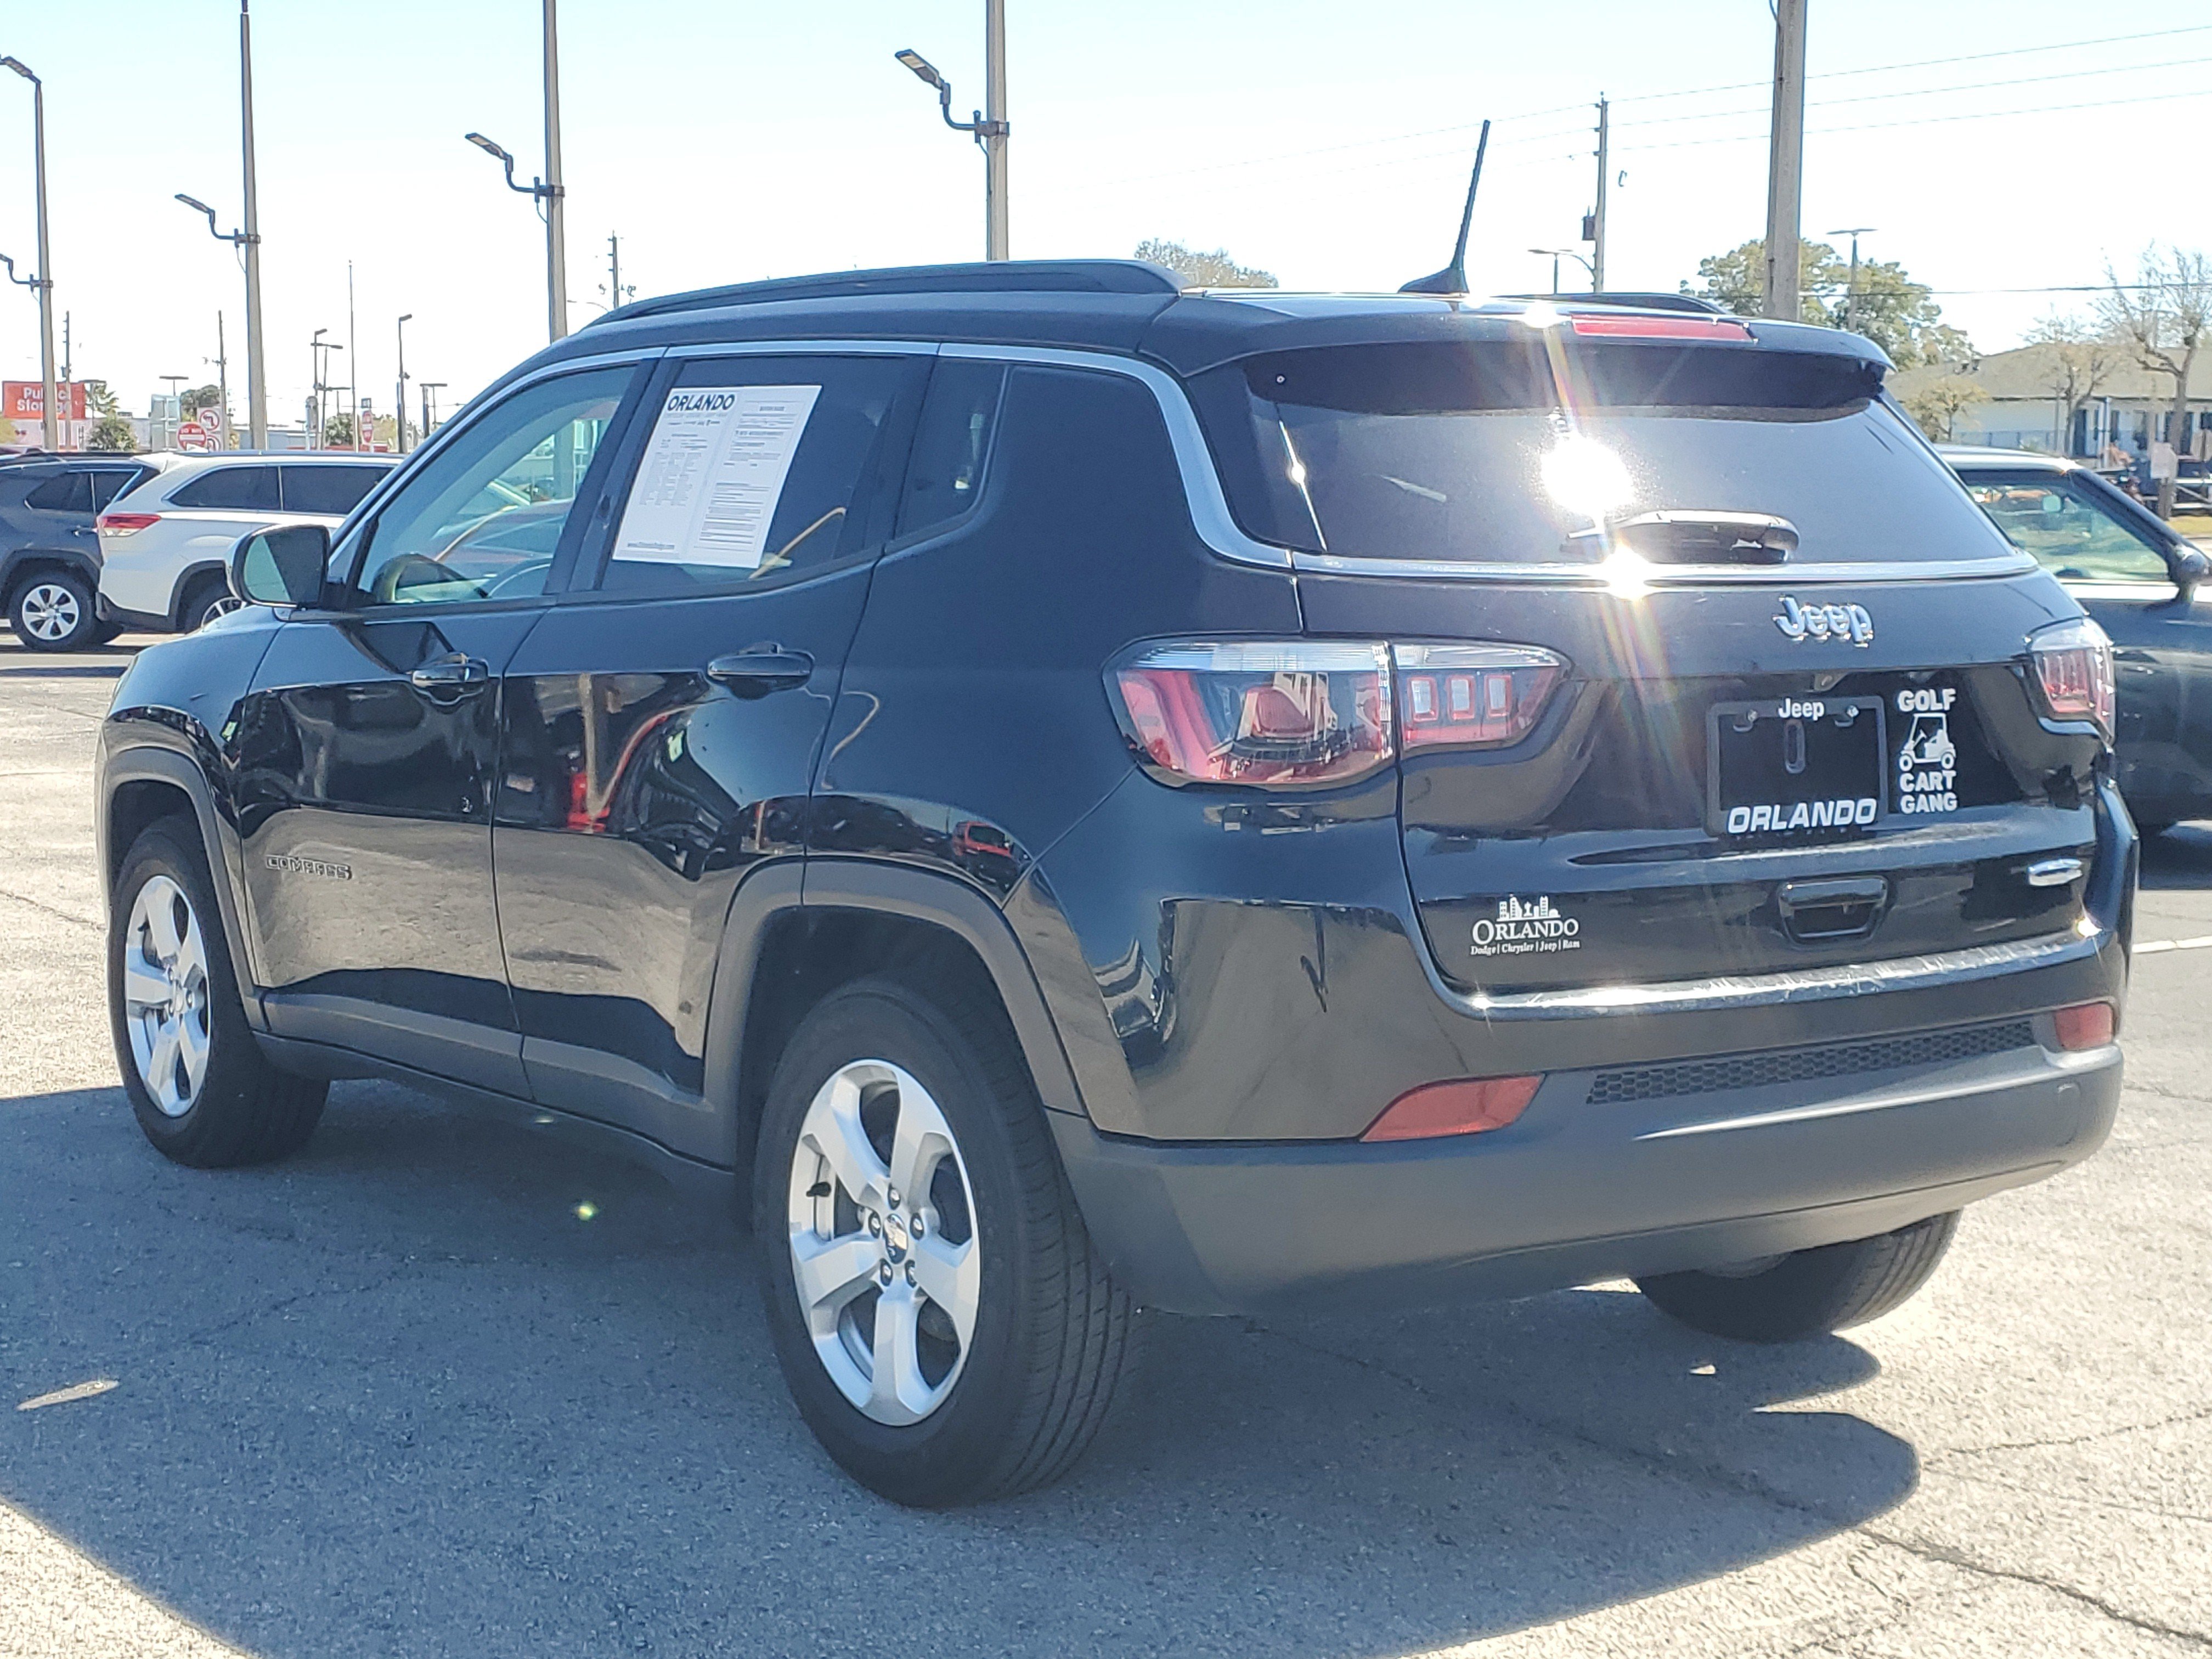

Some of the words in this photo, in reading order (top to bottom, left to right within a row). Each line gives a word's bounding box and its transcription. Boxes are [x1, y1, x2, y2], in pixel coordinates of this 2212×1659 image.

[667, 394, 735, 411] ORLANDO
[1773, 594, 1874, 648] Jeep
[1778, 698, 1825, 721] Jeep
[1898, 689, 1956, 712] GOLF
[1899, 770, 1957, 792] CART
[1900, 792, 1958, 813] GANG
[1728, 798, 1877, 834] ORLANDO
[1472, 918, 1579, 945] ORLANDO
[1471, 945, 1496, 956] Dodge
[1502, 942, 1534, 954] Chrysler
[1540, 940, 1557, 952] Jeep
[1563, 940, 1581, 949] Ram
